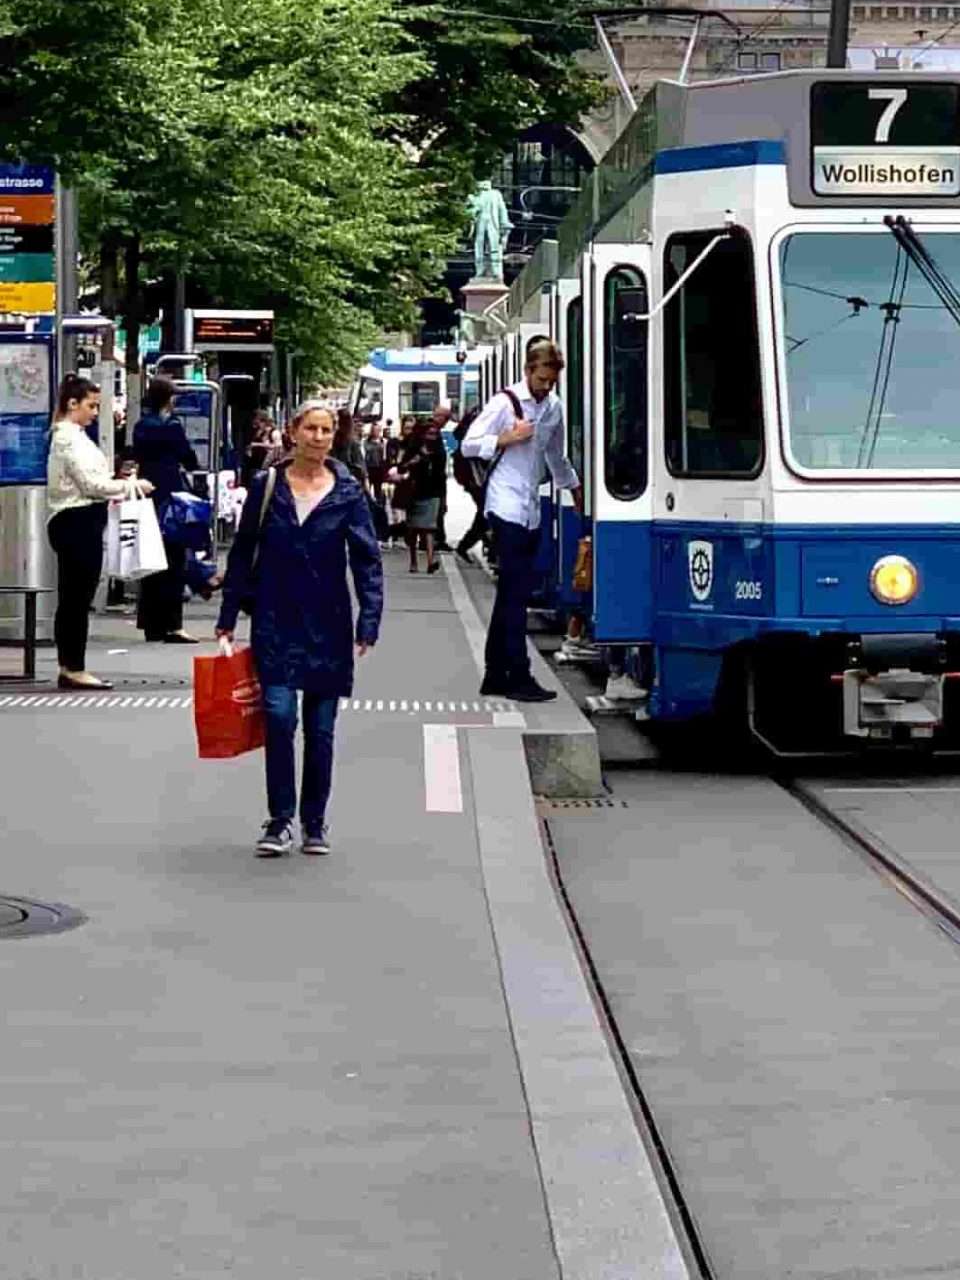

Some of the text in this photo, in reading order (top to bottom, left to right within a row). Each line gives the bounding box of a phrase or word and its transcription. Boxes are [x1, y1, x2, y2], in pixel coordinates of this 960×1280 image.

[868, 88, 908, 142] 7
[822, 164, 954, 183] Wollishofen
[735, 581, 762, 600] 2005
